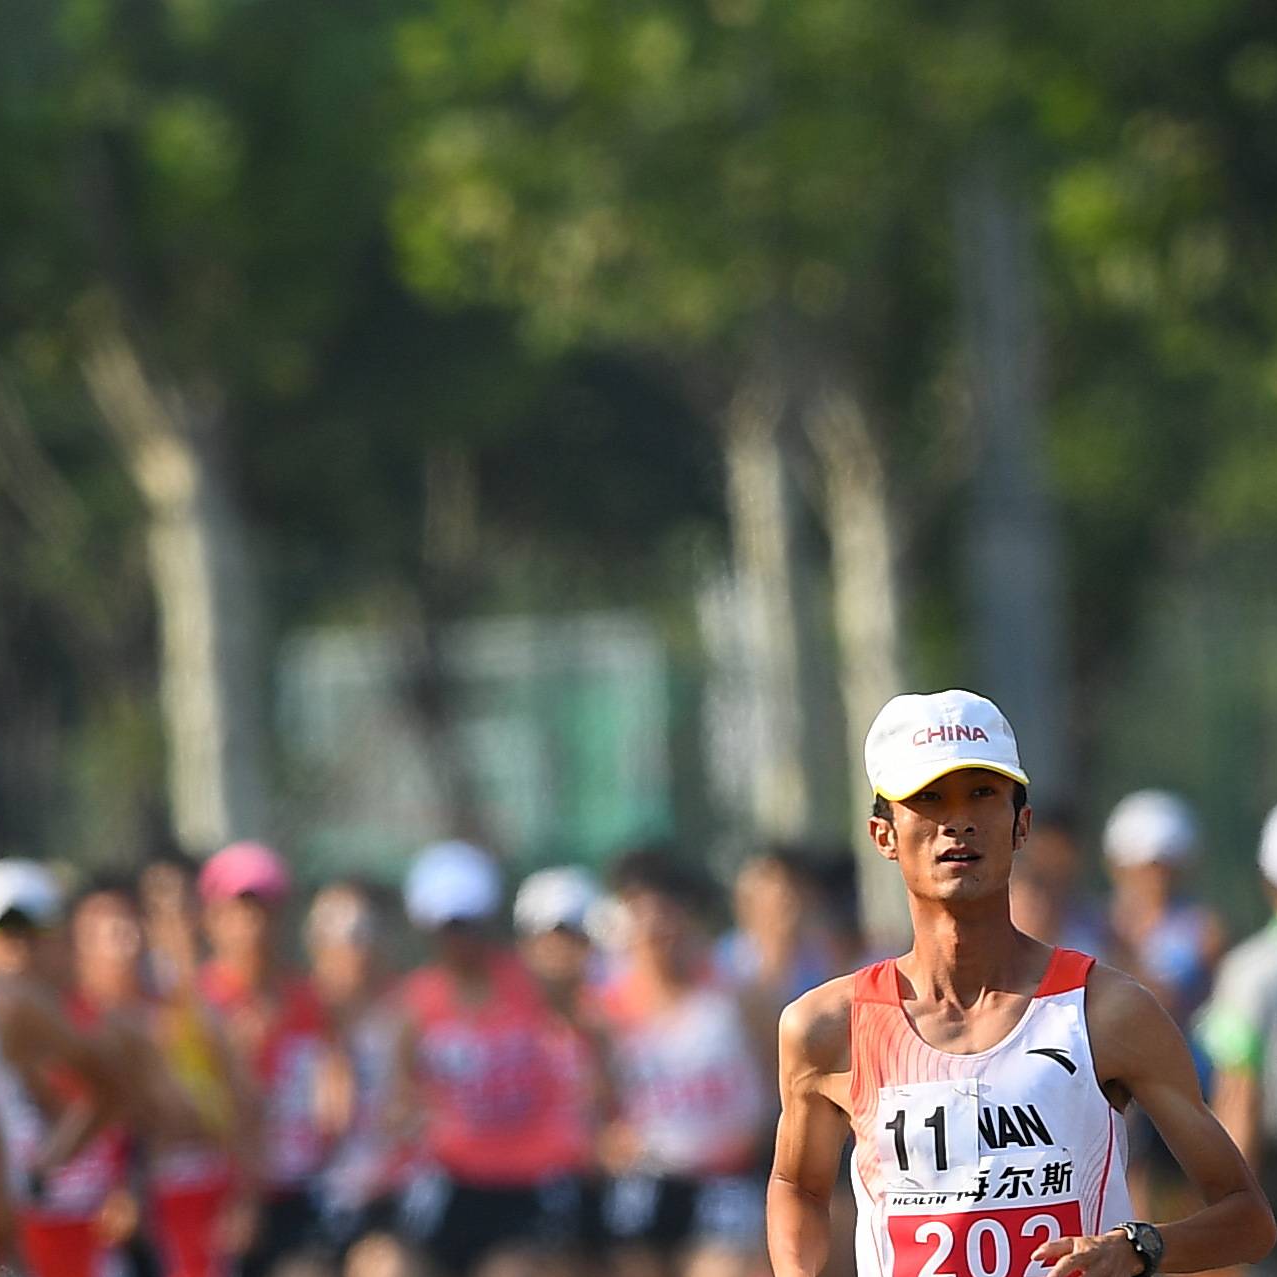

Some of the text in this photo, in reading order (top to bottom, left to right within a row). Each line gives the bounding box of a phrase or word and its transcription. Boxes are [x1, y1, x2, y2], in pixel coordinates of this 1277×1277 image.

[913, 724, 989, 746] CHINA
[885, 1106, 948, 1171] 11
[892, 1196, 947, 1206] HEALTH
